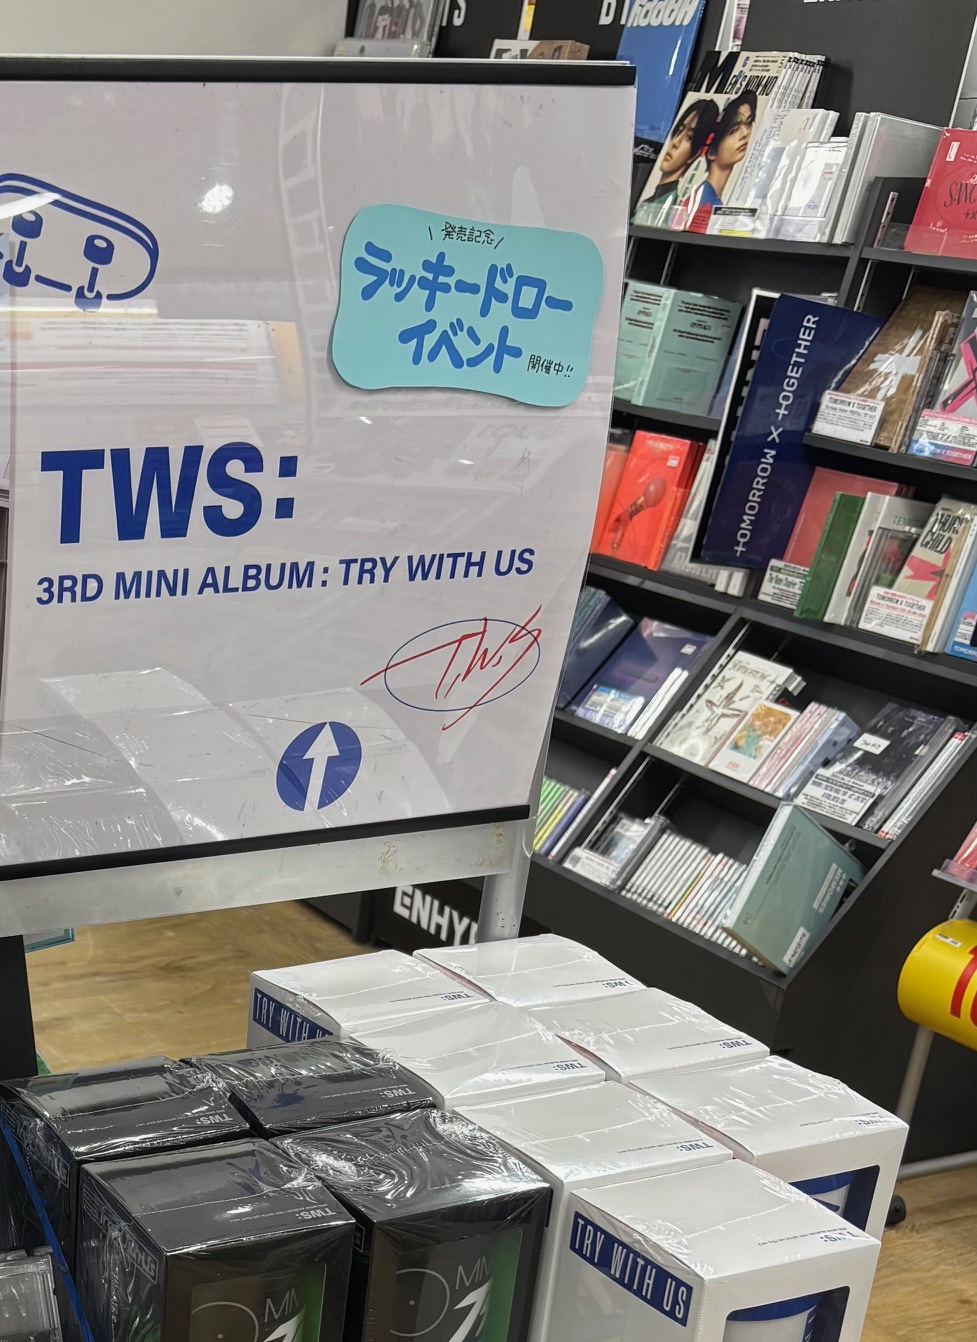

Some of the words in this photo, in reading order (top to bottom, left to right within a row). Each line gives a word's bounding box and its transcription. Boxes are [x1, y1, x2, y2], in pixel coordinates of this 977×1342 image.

[441, 221, 496, 247] 発売記念
[353, 241, 574, 321] ラッキードロー
[398, 318, 523, 375] イベント
[39, 441, 298, 545] TWS:
[36, 573, 104, 607] 3RD
[114, 567, 189, 599] MINI
[197, 561, 314, 595] ALBUM
[338, 556, 402, 587] TRY
[407, 550, 487, 582] WITH
[493, 548, 535, 577] US
[256, 993, 275, 1028] TRY
[279, 1008, 310, 1041] WITH
[720, 1038, 753, 1052] TWS:
[554, 1058, 588, 1074] TWS:
[380, 1086, 417, 1102] TWS:
[193, 1111, 234, 1127] TWS:
[678, 1139, 713, 1154] TWS:
[295, 1205, 337, 1220] TWS:
[575, 1218, 604, 1263] TRY
[610, 1242, 656, 1300] WITH
[663, 1277, 687, 1319] US
